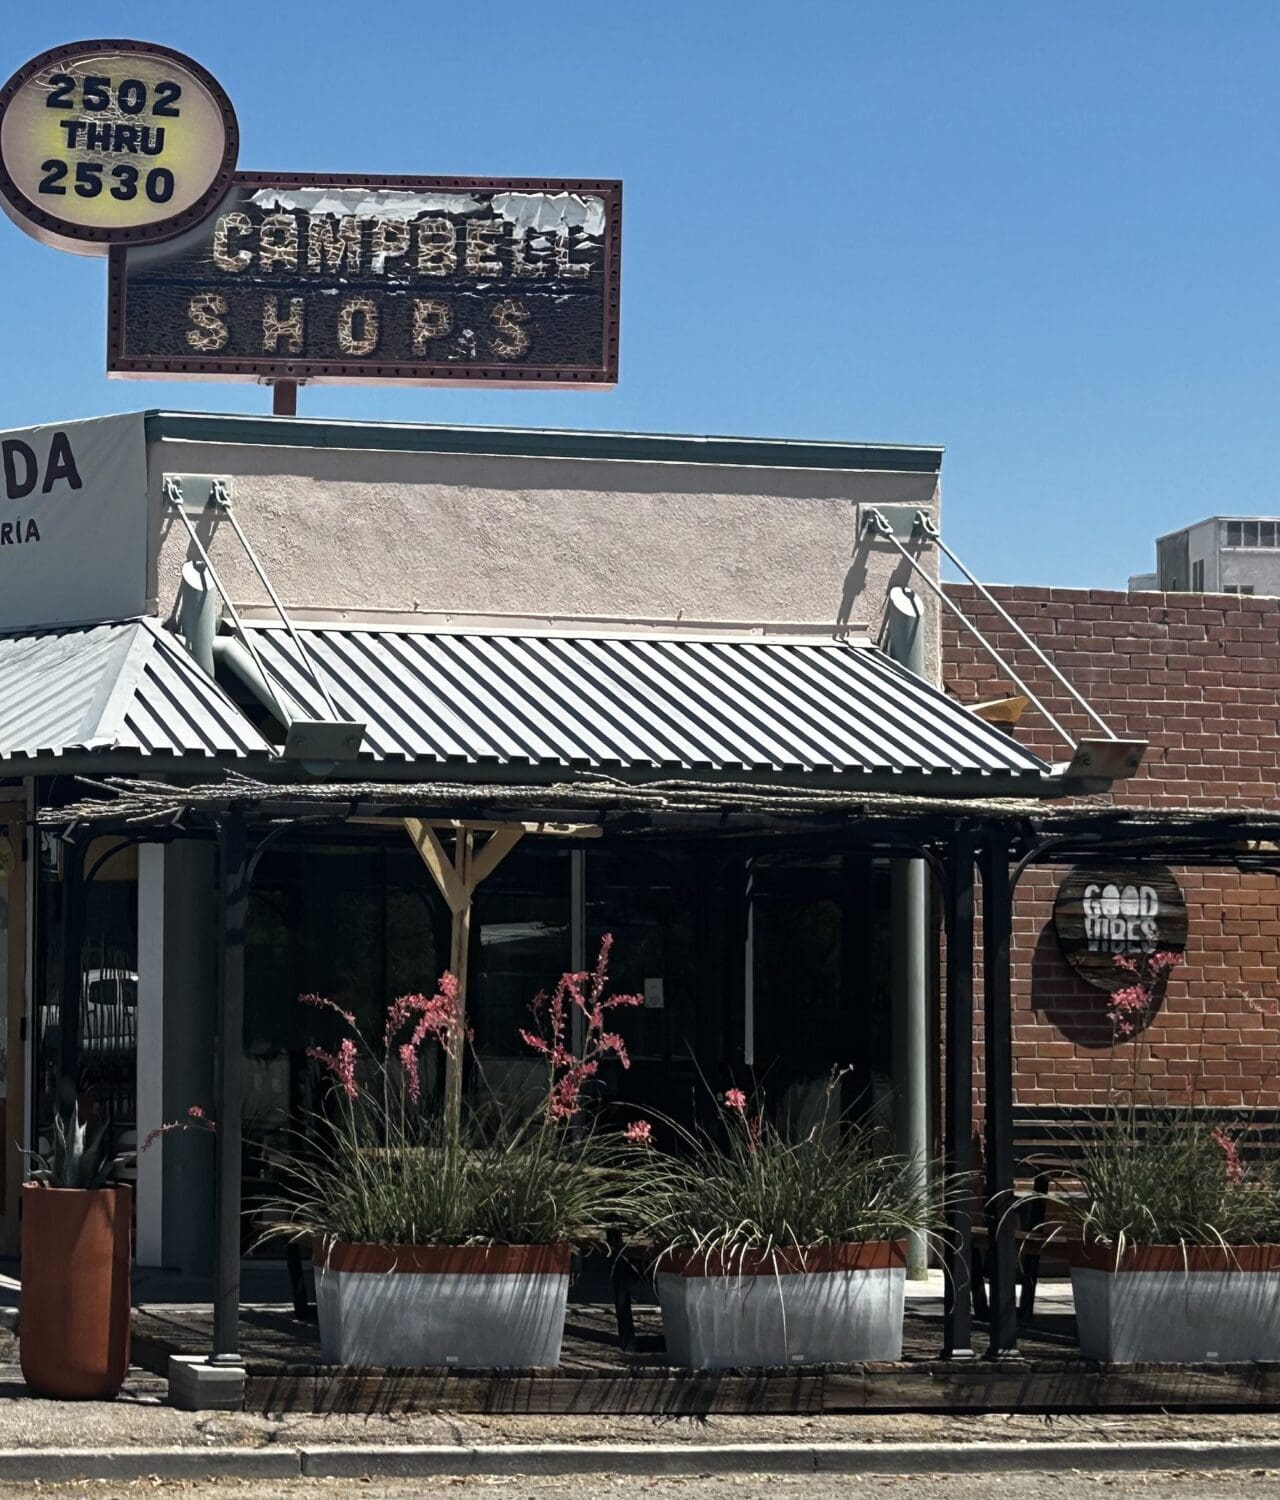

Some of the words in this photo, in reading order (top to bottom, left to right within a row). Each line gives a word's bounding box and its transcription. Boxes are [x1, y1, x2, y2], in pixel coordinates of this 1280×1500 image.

[46, 73, 182, 118] 2502
[60, 119, 166, 156] THRU
[38, 159, 175, 203] 2530
[213, 210, 593, 280] CAMPBELL
[185, 294, 531, 359] SHOPS
[1082, 884, 1159, 916] GOOD
[1084, 916, 1160, 953] VIBES
